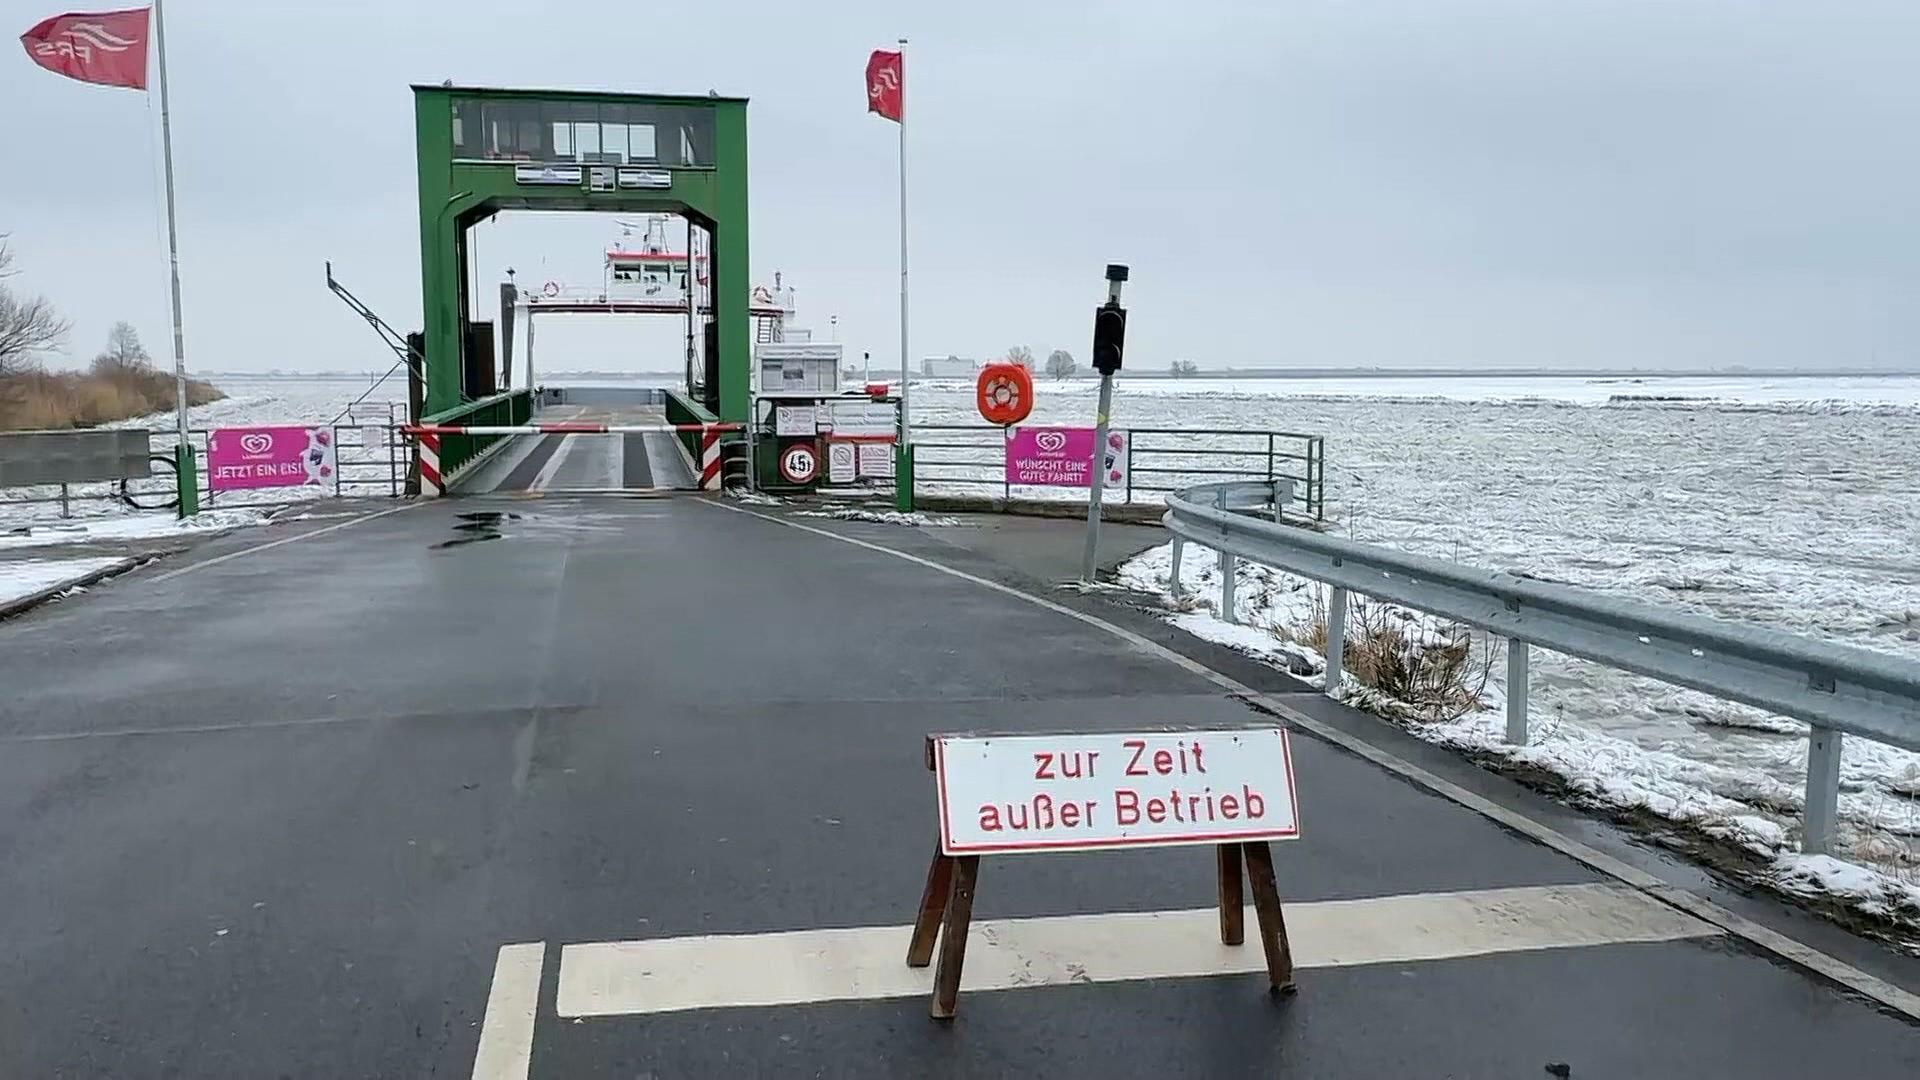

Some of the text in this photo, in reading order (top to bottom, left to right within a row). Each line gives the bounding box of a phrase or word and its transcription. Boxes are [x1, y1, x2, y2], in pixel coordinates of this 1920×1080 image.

[214, 464, 254, 479] JETZT
[256, 463, 277, 477] EIN
[1034, 739, 1207, 781] zur Zeit
[978, 784, 1266, 833] außer Betrieb
